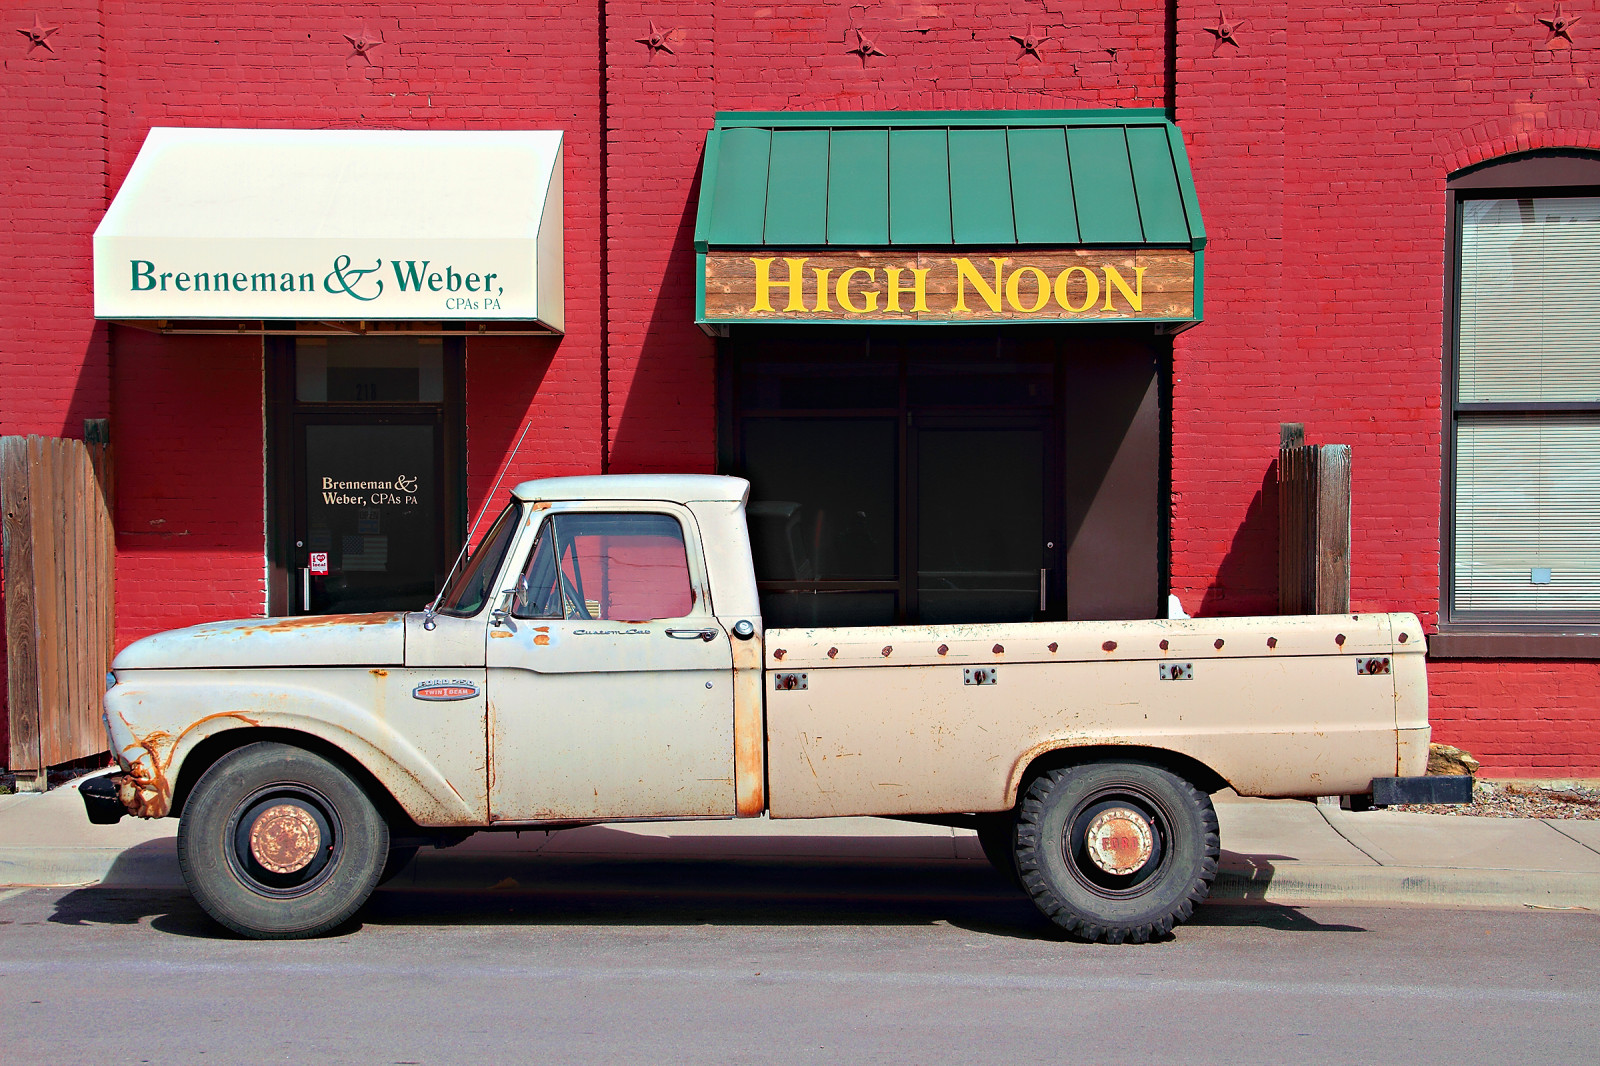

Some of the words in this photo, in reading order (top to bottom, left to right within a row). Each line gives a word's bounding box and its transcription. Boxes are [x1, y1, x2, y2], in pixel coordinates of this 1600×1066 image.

[130, 260, 315, 292] Brenneman
[323, 254, 383, 301] &
[391, 260, 504, 297] Weber,
[445, 298, 479, 311] CPAs
[483, 298, 501, 311] PA
[322, 476, 392, 490] Brenneman
[394, 474, 418, 493] &
[322, 492, 366, 506] Weber,
[371, 493, 401, 505] CPAs
[405, 495, 418, 505] PA
[418, 679, 450, 688] FORD
[452, 679, 475, 687] 250
[1102, 837, 1138, 851] FORD
